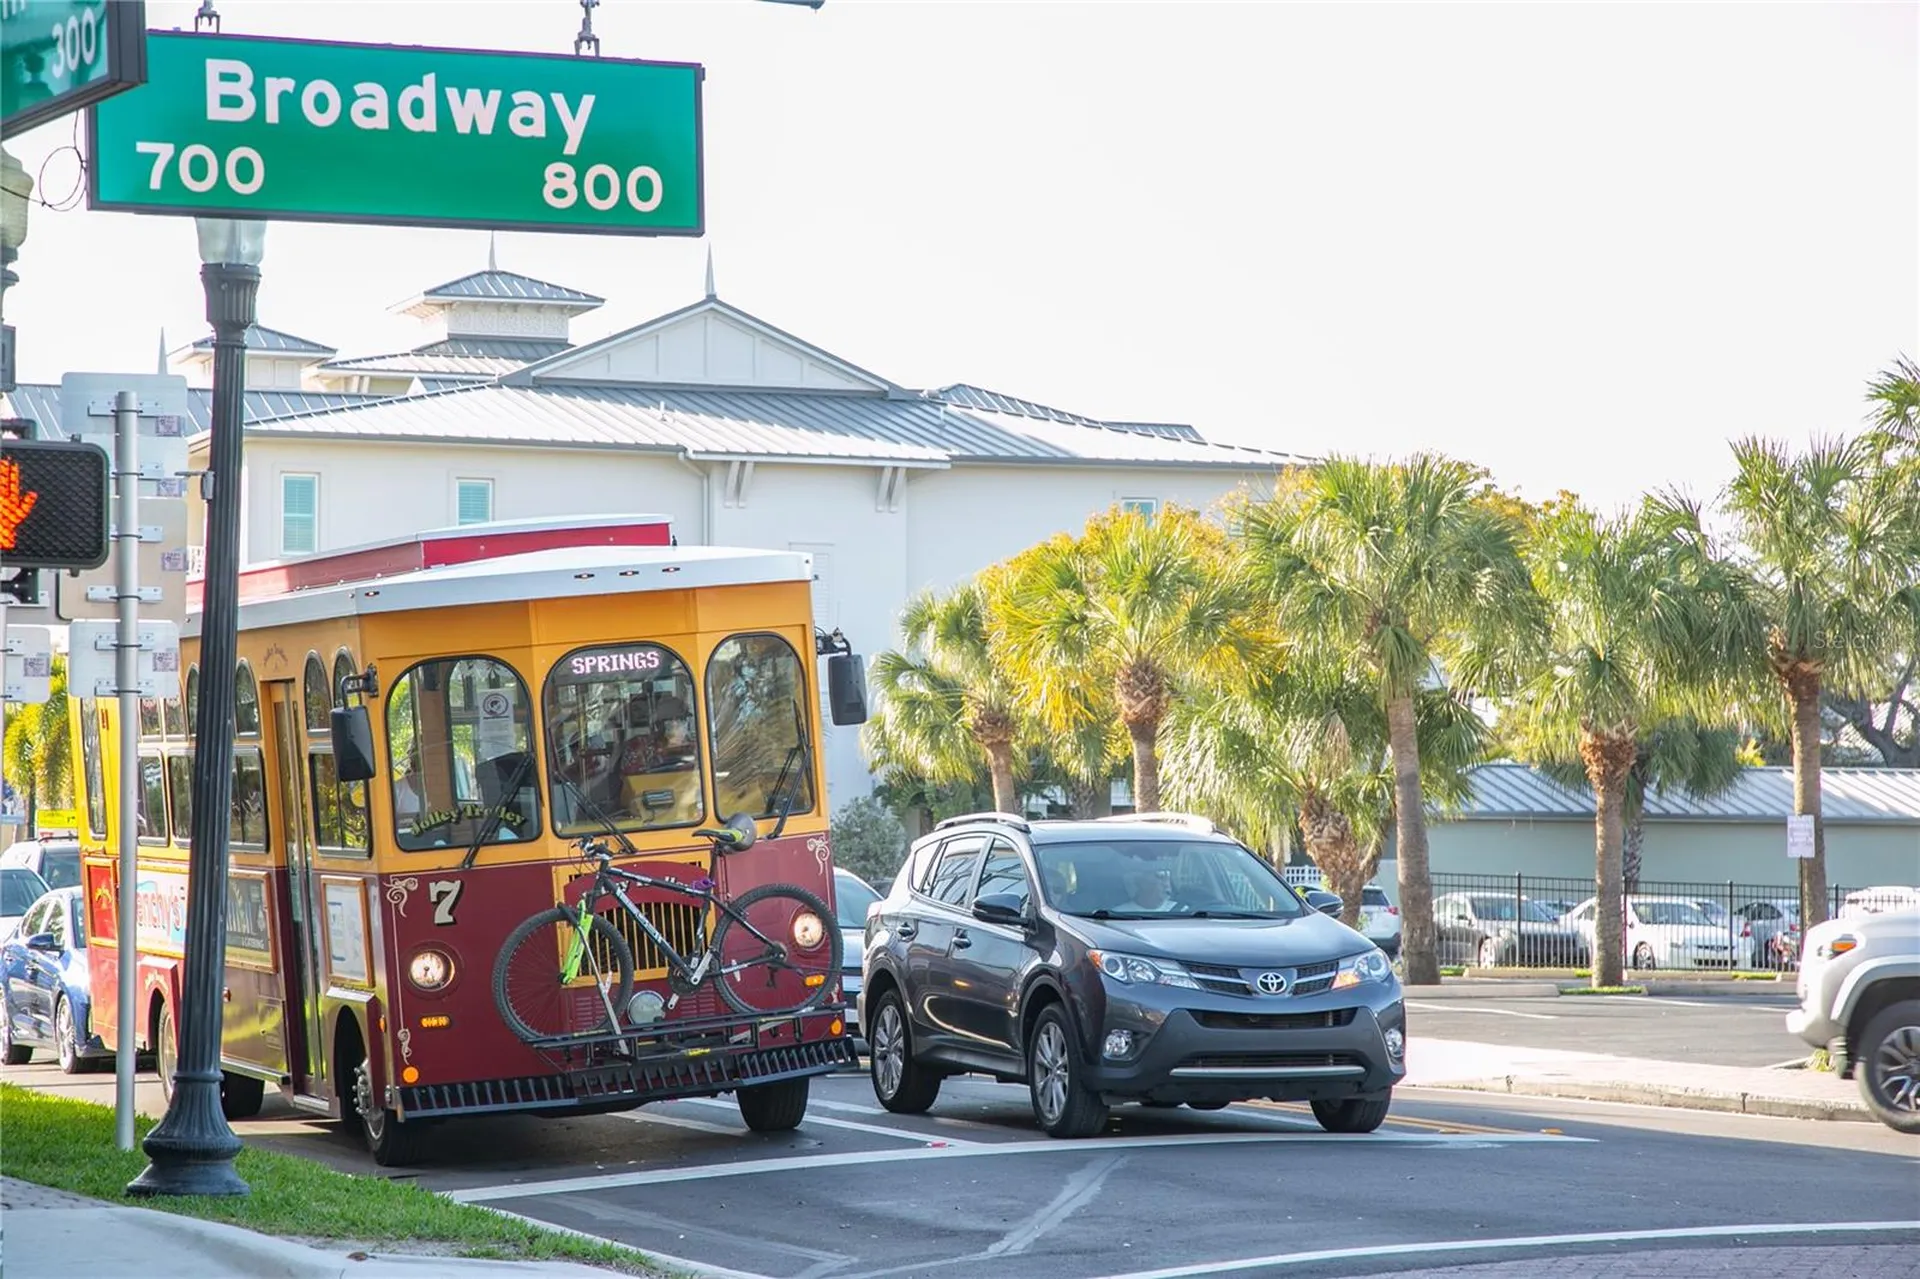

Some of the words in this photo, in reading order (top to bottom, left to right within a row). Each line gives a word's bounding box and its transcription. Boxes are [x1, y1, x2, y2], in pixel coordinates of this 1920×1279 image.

[51, 8, 96, 79] 300
[205, 58, 596, 155] Broadway
[135, 141, 265, 194] 700
[542, 161, 663, 212] 800
[571, 650, 660, 675] SPRINGS
[411, 808, 461, 836] Jolley
[464, 803, 526, 827] Troley
[428, 879, 462, 924] 7
